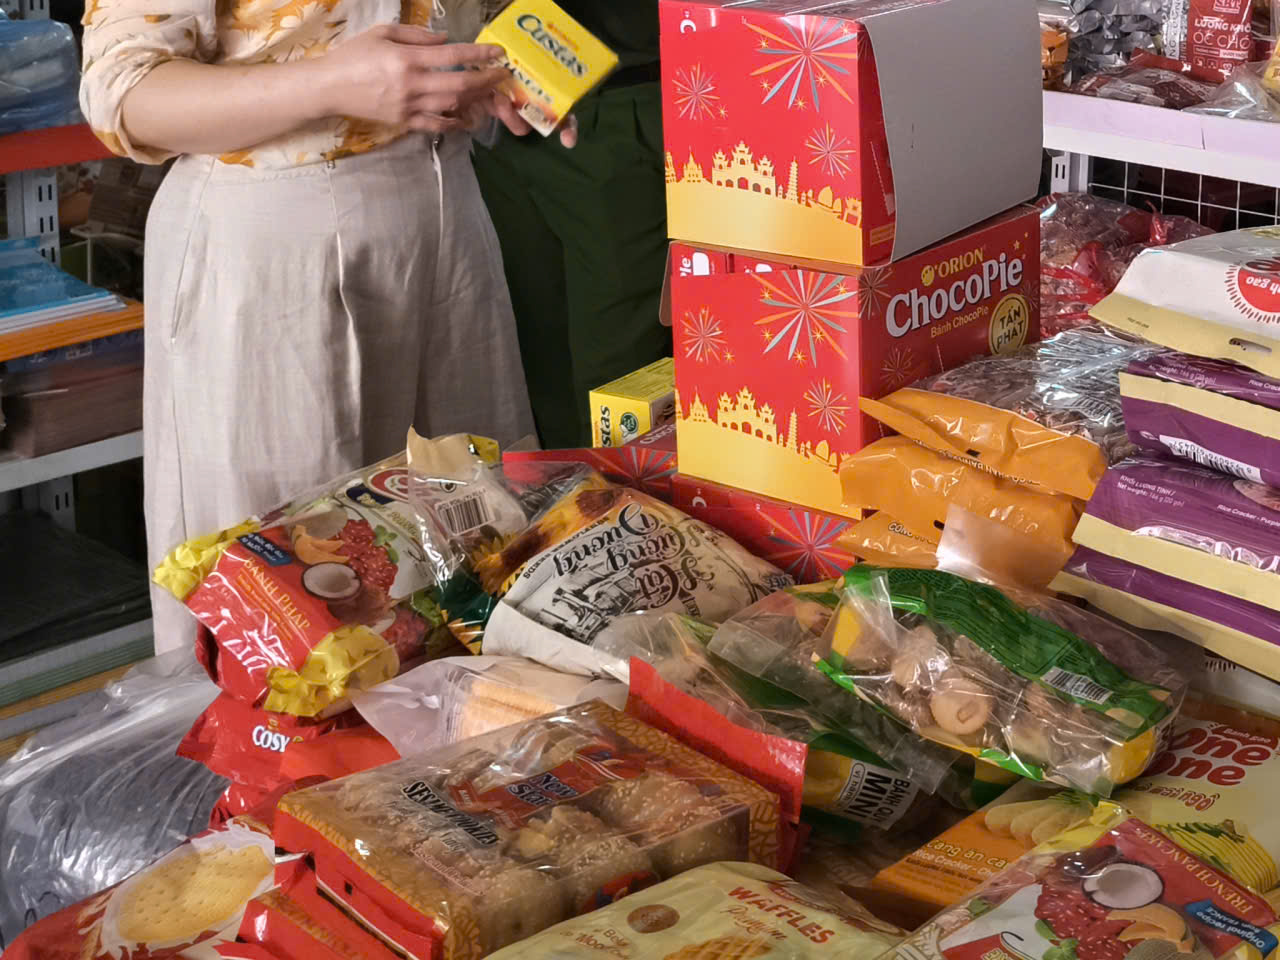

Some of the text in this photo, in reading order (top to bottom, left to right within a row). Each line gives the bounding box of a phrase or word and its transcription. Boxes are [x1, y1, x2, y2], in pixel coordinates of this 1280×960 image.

[517, 14, 587, 77] Custas
[937, 247, 984, 278] ORION
[886, 252, 1024, 338] ChocoPie
[930, 305, 990, 339] Bánh ChocoPie
[1231, 507, 1257, 521] Cracker
[1260, 516, 1280, 529] Purple
[252, 724, 291, 753] COSY
[508, 783, 553, 806] Star
[531, 772, 579, 798] New
[843, 771, 891, 819] MINI
[1196, 869, 1255, 915] FRENCH
[728, 885, 836, 945] WAFFLES
[1196, 910, 1266, 950] Original recipe
